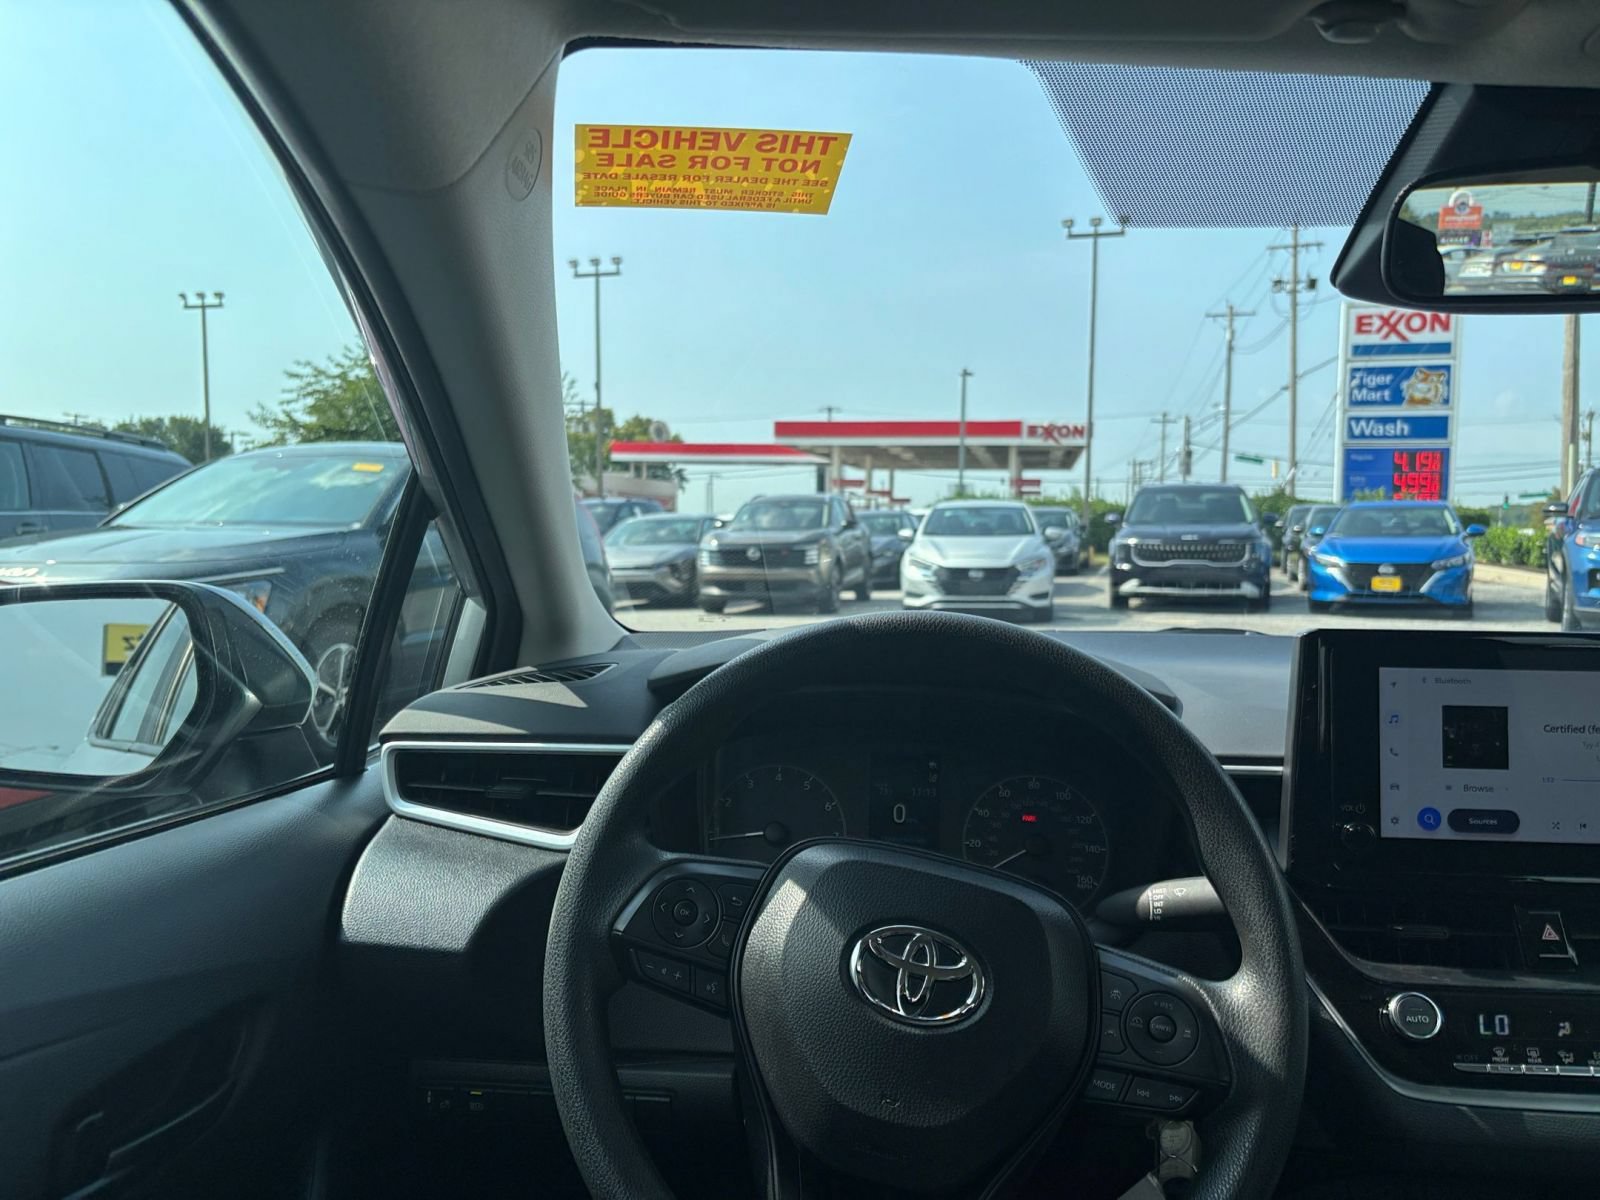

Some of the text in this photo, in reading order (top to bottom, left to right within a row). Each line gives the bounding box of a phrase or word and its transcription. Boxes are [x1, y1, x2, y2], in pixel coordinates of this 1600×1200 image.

[1355, 310, 1450, 341] EXXON
[1351, 370, 1393, 389] Tiger
[1351, 388, 1391, 402] Mart
[1350, 419, 1409, 436] Wash
[1027, 424, 1084, 445] EXXON
[1434, 677, 1471, 685] Bluetooth
[1543, 724, 1586, 734] Certified
[775, 773, 782, 781] 4
[748, 780, 754, 789] 3
[803, 781, 811, 790] 5
[1463, 784, 1494, 792] Browse
[1056, 792, 1071, 800] 100
[825, 802, 832, 811] 6
[893, 804, 906, 823] 0
[977, 809, 990, 817] 40
[1468, 817, 1498, 825] Sources
[969, 839, 982, 848] 20
[679, 908, 689, 917] OK
[1406, 1015, 1430, 1023] AUTO
[1479, 1014, 1510, 1036] LO
[1092, 1079, 1116, 1091] MODE
